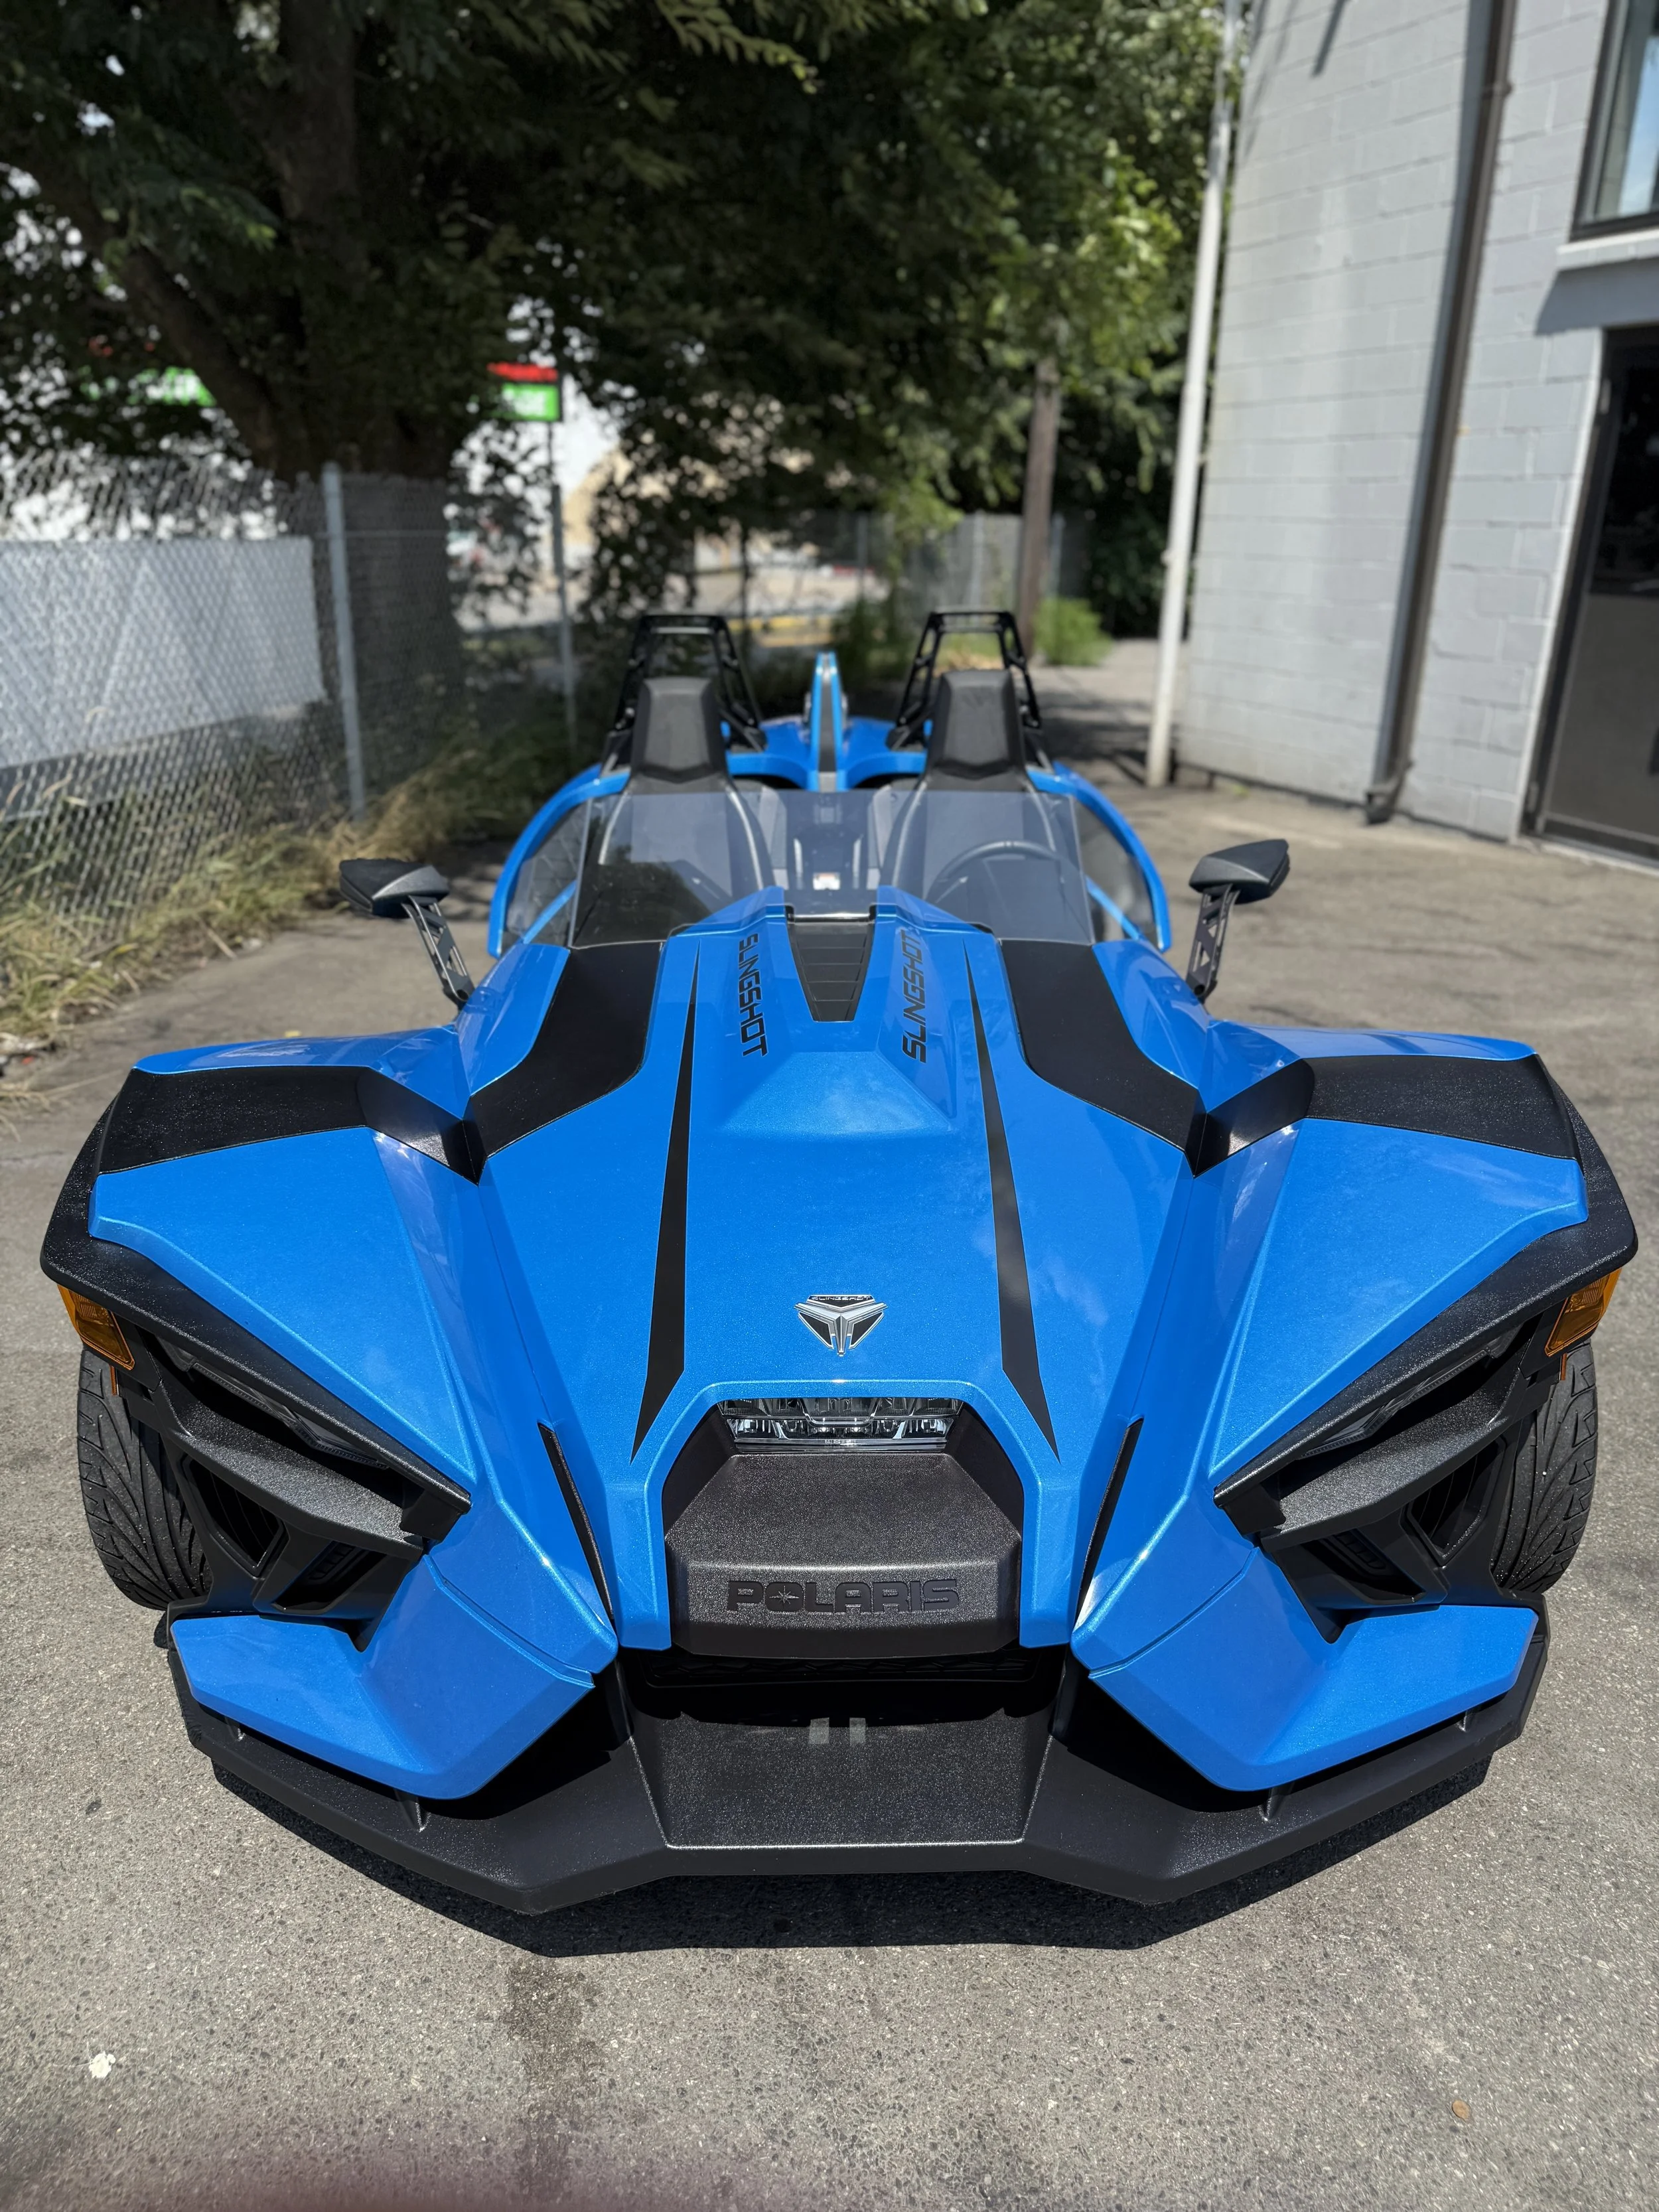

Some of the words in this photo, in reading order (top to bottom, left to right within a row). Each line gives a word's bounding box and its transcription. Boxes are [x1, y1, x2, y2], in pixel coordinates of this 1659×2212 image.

[739, 933, 768, 1057] SLINGSHOT
[901, 929, 926, 1063] SLINGSHOT
[729, 1580, 960, 1613] POLARIS
